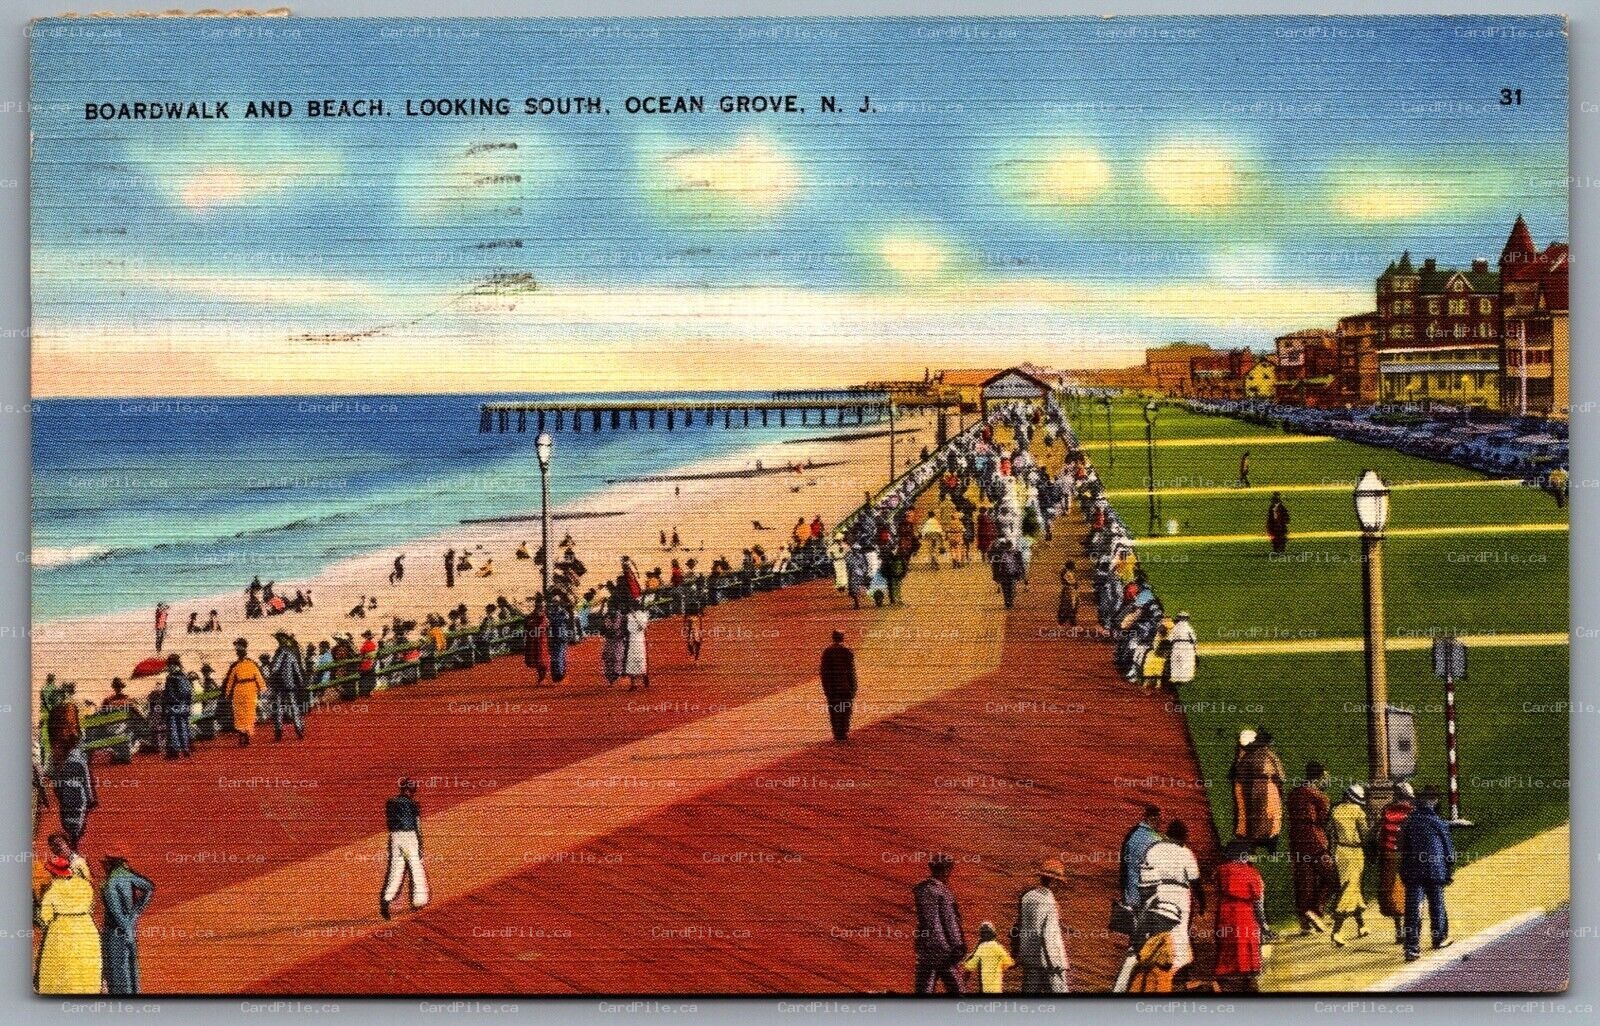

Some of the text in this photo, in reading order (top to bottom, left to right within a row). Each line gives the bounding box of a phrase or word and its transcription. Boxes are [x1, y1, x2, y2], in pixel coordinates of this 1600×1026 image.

[84, 101, 230, 121] BOARDWALK
[245, 100, 293, 119] AND
[406, 98, 511, 117] LOOKING
[624, 95, 705, 115] OCEAN
[719, 95, 805, 115] GROVE,
[820, 95, 843, 114] N.
[858, 95, 877, 114] J.
[1499, 88, 1522, 106] 31
